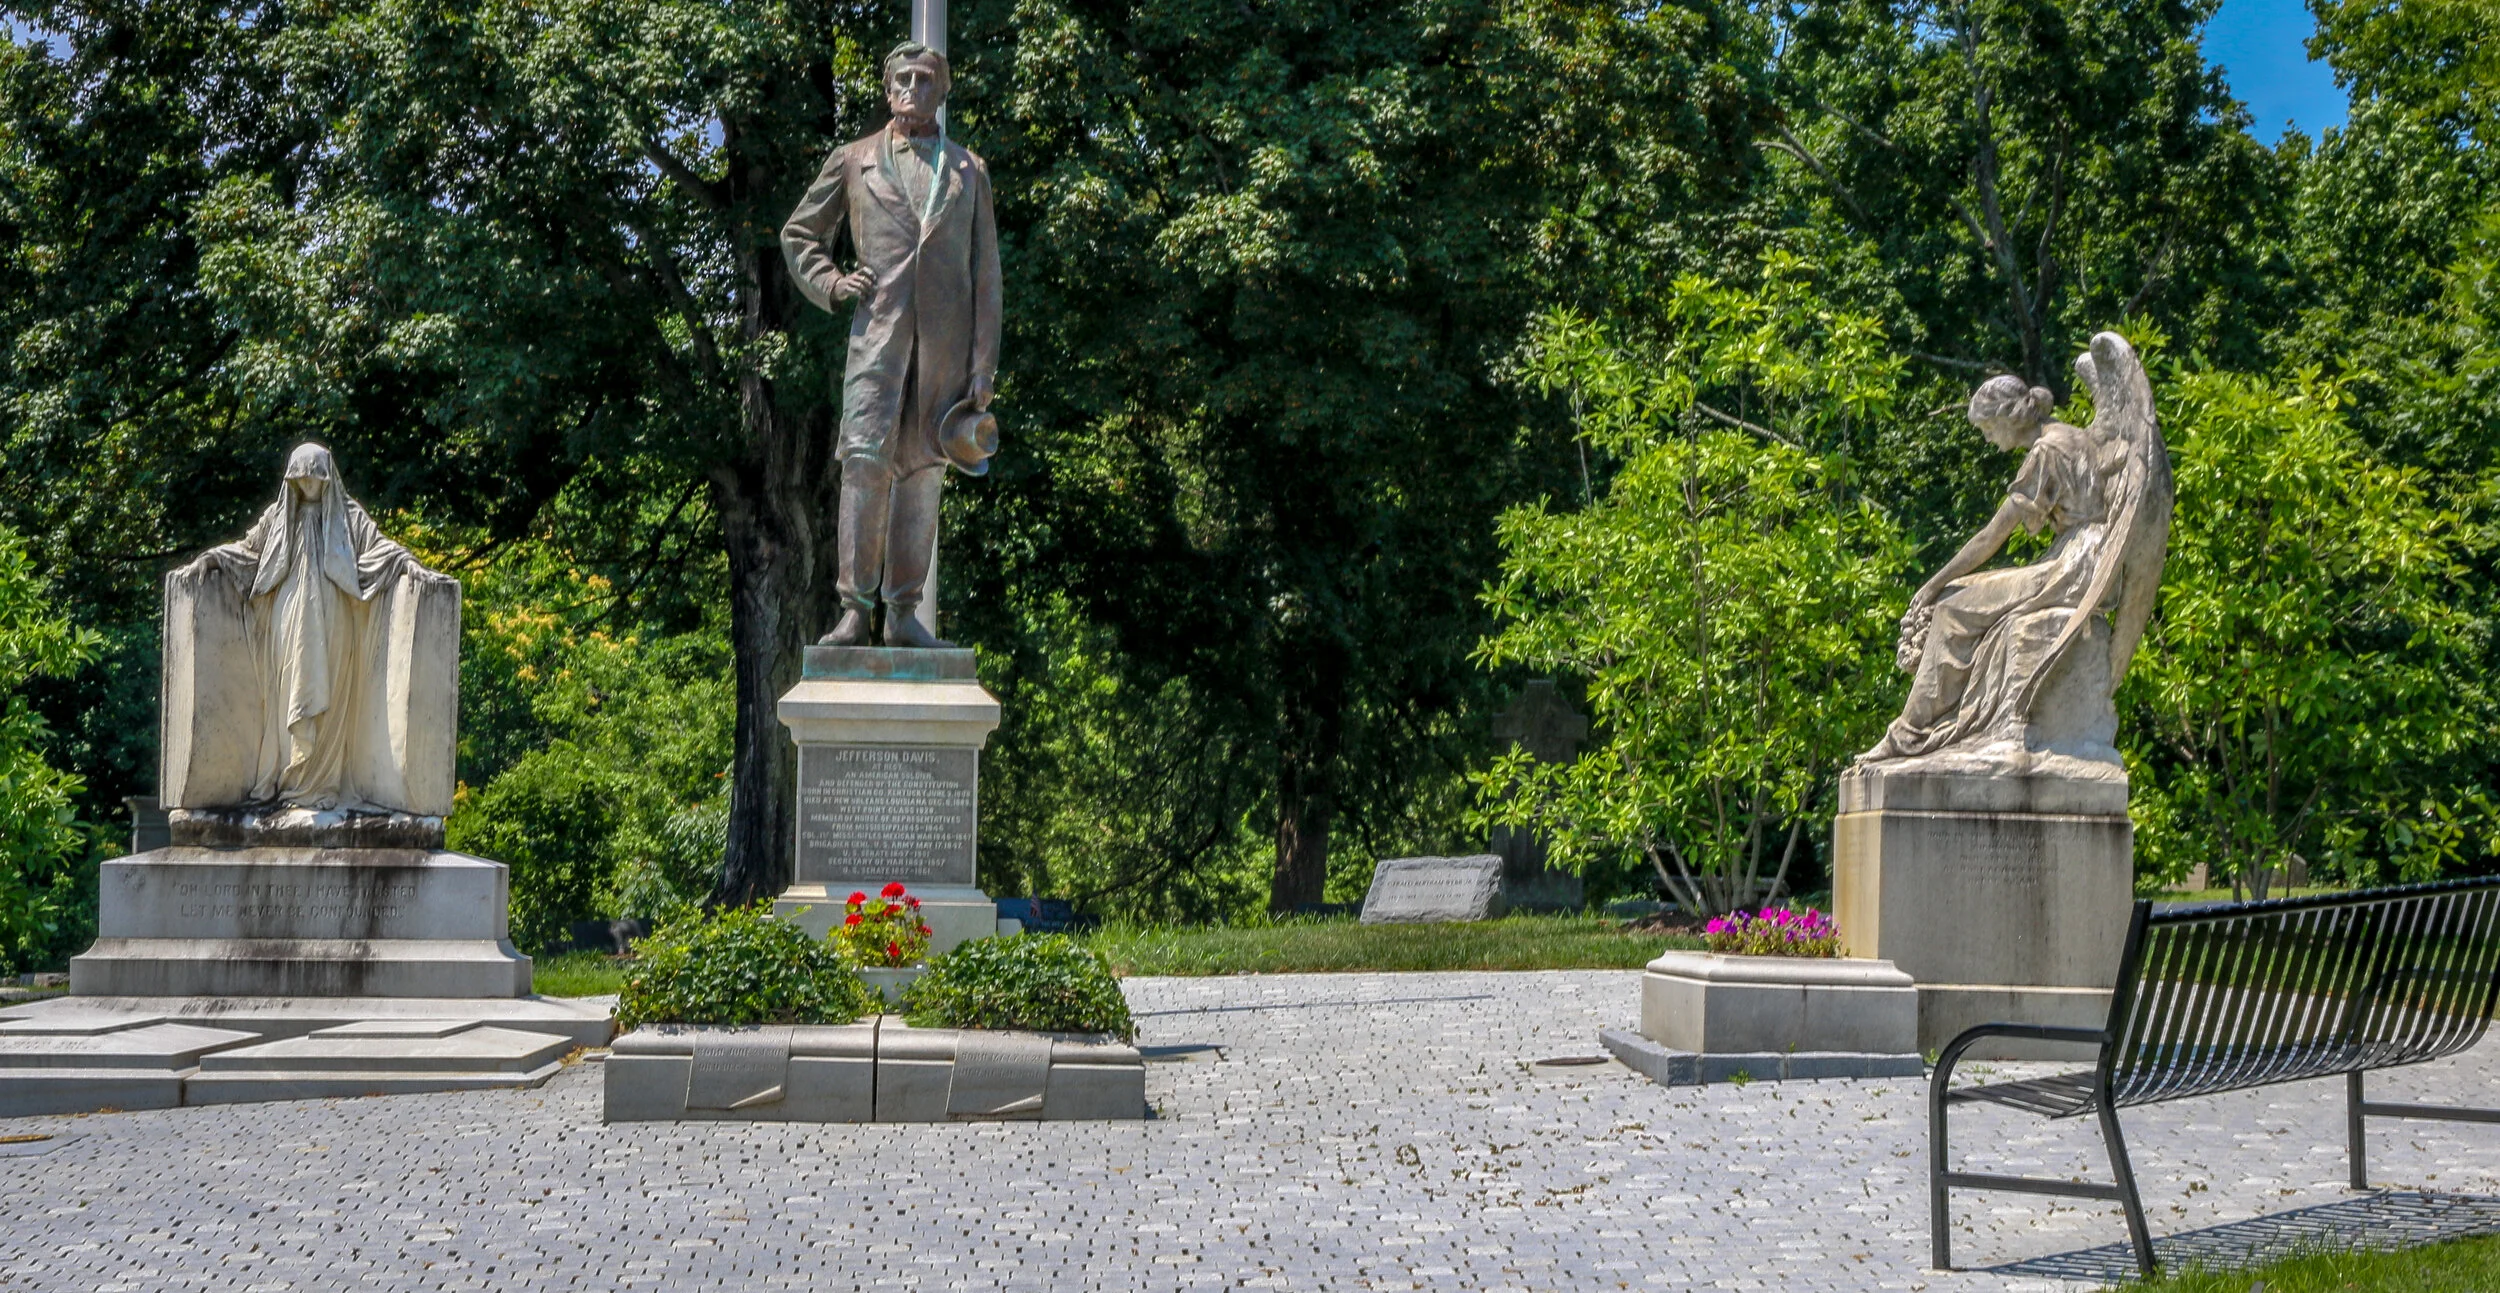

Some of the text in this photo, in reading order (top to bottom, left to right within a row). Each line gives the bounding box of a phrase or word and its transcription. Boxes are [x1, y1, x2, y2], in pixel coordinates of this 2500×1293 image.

[835, 750, 898, 762] JEFFERSON
[872, 763, 882, 771] AT
[859, 772, 899, 780] AMERICAN
[819, 779, 959, 789] AND DEFENDER OF THE CONSTITUTION
[832, 787, 873, 796] CHRISTIAN
[887, 789, 927, 797] KENTUCKY
[927, 789, 945, 798] JUNE
[803, 796, 821, 804] DIED
[823, 796, 832, 804] AT
[885, 798, 928, 806] LOUISIANA
[840, 806, 861, 814] WEST
[862, 806, 886, 814] POINT
[888, 806, 915, 814] CLASS
[810, 814, 844, 822] MEMBER
[880, 815, 890, 823] OF
[892, 815, 961, 824] REPRESENTATIVES
[831, 823, 853, 831] FROM
[855, 823, 900, 831] MISSISSIPPI
[882, 832, 915, 841] MEXICAN
[916, 833, 932, 841] WAR
[809, 840, 850, 849] BRIGADIER
[891, 841, 914, 849] ARMY
[916, 841, 933, 849] MAY
[861, 849, 889, 857] SENATE
[828, 857, 873, 866] SECRETARY
[874, 858, 884, 866] OF
[886, 858, 904, 866] WAR
[861, 866, 890, 875] SENATE
[204, 883, 241, 897] LORD
[244, 883, 261, 897] IN
[266, 883, 301, 897] THEE
[315, 884, 351, 898] HAVE
[355, 884, 418, 898] TRUSTED
[180, 904, 205, 917] LET
[212, 904, 233, 918] ME
[239, 904, 283, 918] NEVER
[287, 904, 305, 918] BE
